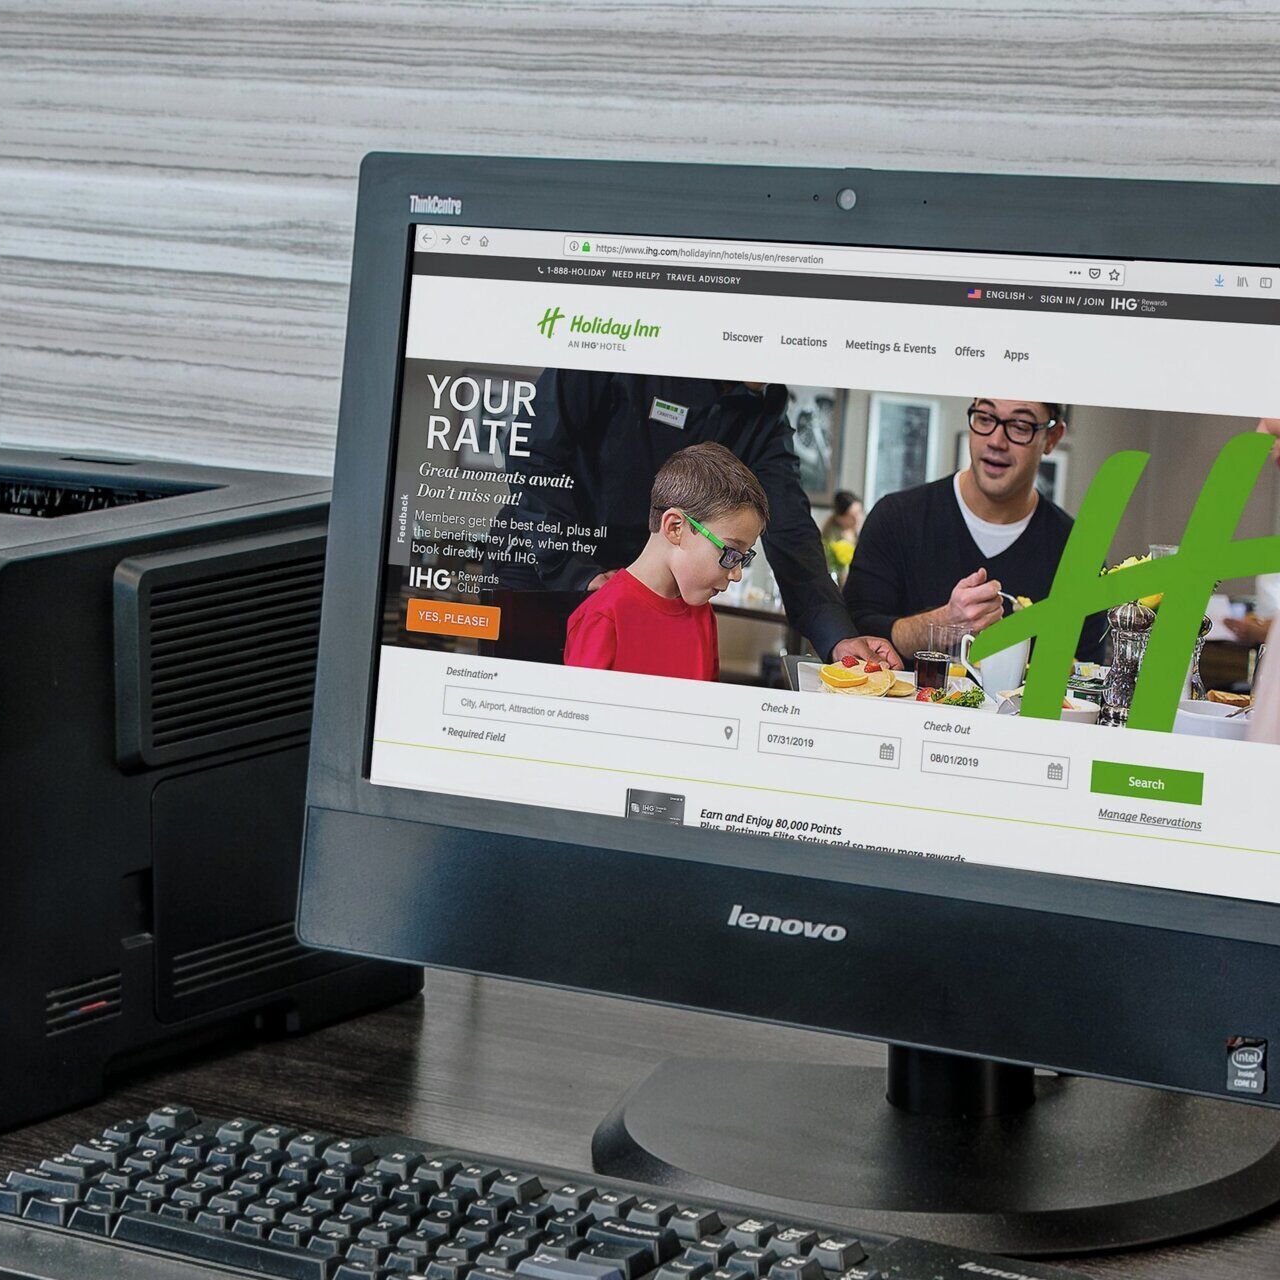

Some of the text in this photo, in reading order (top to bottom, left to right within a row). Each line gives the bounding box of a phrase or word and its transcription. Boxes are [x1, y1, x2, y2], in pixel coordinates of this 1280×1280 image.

[410, 195, 462, 215] ThinkCentre
[596, 244, 824, 264] https://www.ihg.com/holidayinn/hotels/us/en/reservation
[547, 266, 741, 285] 1-888-HOLIDAY NEED HELP? TRAVEL ADVISORY
[986, 290, 1025, 300] ENGLISH
[1040, 295, 1063, 304] SIGN
[1065, 296, 1075, 305] IN
[1083, 297, 1105, 306] JOIN
[1111, 298, 1138, 311] IHG
[1141, 299, 1168, 307] Rewards
[570, 315, 660, 340] Holiday Inn
[600, 343, 626, 352] HOTEL
[723, 332, 763, 344] Discover
[780, 335, 827, 348] Locations
[845, 340, 936, 355] Meetings & Events
[955, 346, 985, 357] Offers
[1004, 350, 1029, 362] Apps
[426, 374, 536, 416] YOUR
[426, 416, 532, 457] RATE
[419, 462, 574, 489] Great moments await:
[417, 483, 522, 506] Don't miss out!
[397, 494, 409, 543] Feedback
[414, 510, 607, 539] Members get the best deal, plus all
[413, 527, 598, 556] the benefits they love, when they
[411, 542, 539, 565] book directly with IHG.
[409, 566, 451, 591] IHG
[458, 571, 499, 585] Rewards
[457, 582, 480, 594] Club
[418, 610, 489, 627] YES, PLEASE!
[460, 697, 589, 721] City, Airport, Attraction or Address
[761, 702, 801, 716] Check In
[447, 727, 506, 743] Required Field
[923, 721, 971, 735] Check Out
[767, 734, 814, 748] 07/31/2019
[930, 753, 979, 768] 08/01/2019
[1128, 776, 1165, 790] Search
[700, 809, 842, 836] Earn and Enjoy 80,000 Points
[1098, 808, 1202, 830] Manage Reservations
[726, 904, 848, 942] lenovo
[1235, 1052, 1258, 1063] intel
